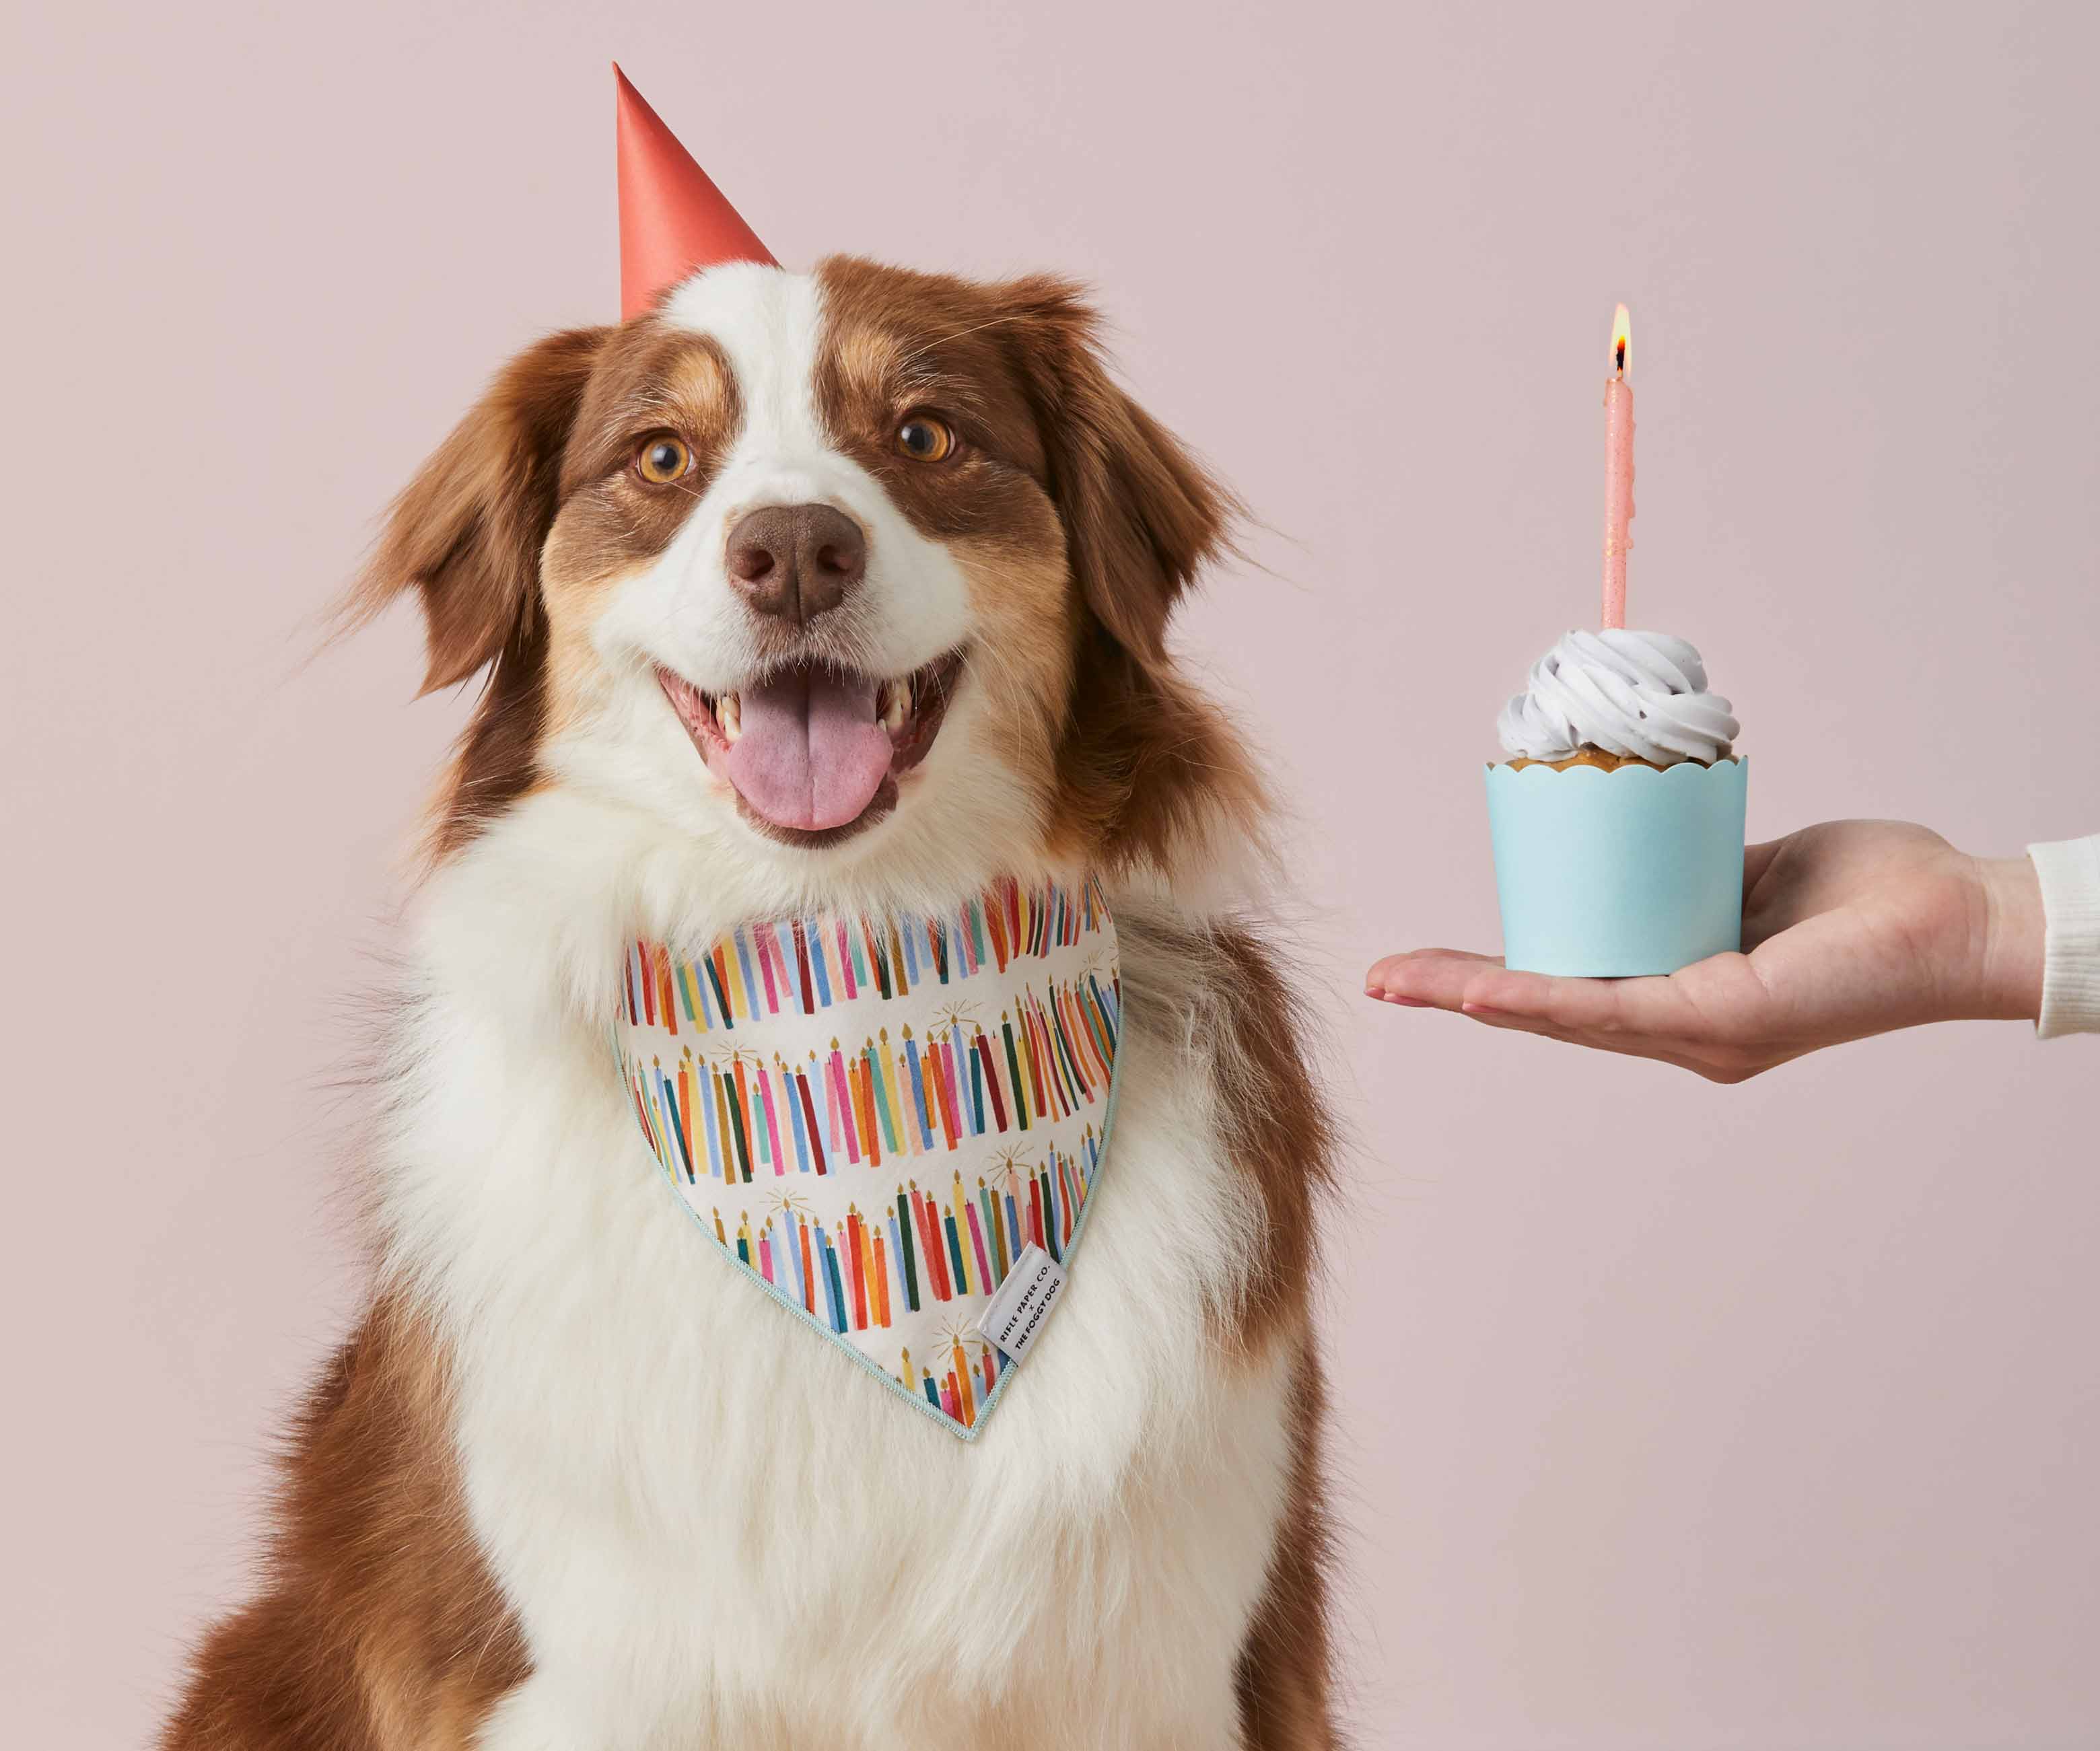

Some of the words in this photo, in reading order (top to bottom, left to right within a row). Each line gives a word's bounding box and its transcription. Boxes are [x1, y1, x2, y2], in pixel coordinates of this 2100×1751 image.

[1000, 1315, 1018, 1342] RIFLE
[1017, 1284, 1038, 1314] PAPER
[1037, 1265, 1051, 1282] CO.
[1015, 1334, 1028, 1350] THE
[1026, 1300, 1046, 1333] FOGGY
[1045, 1278, 1060, 1301] DOG
